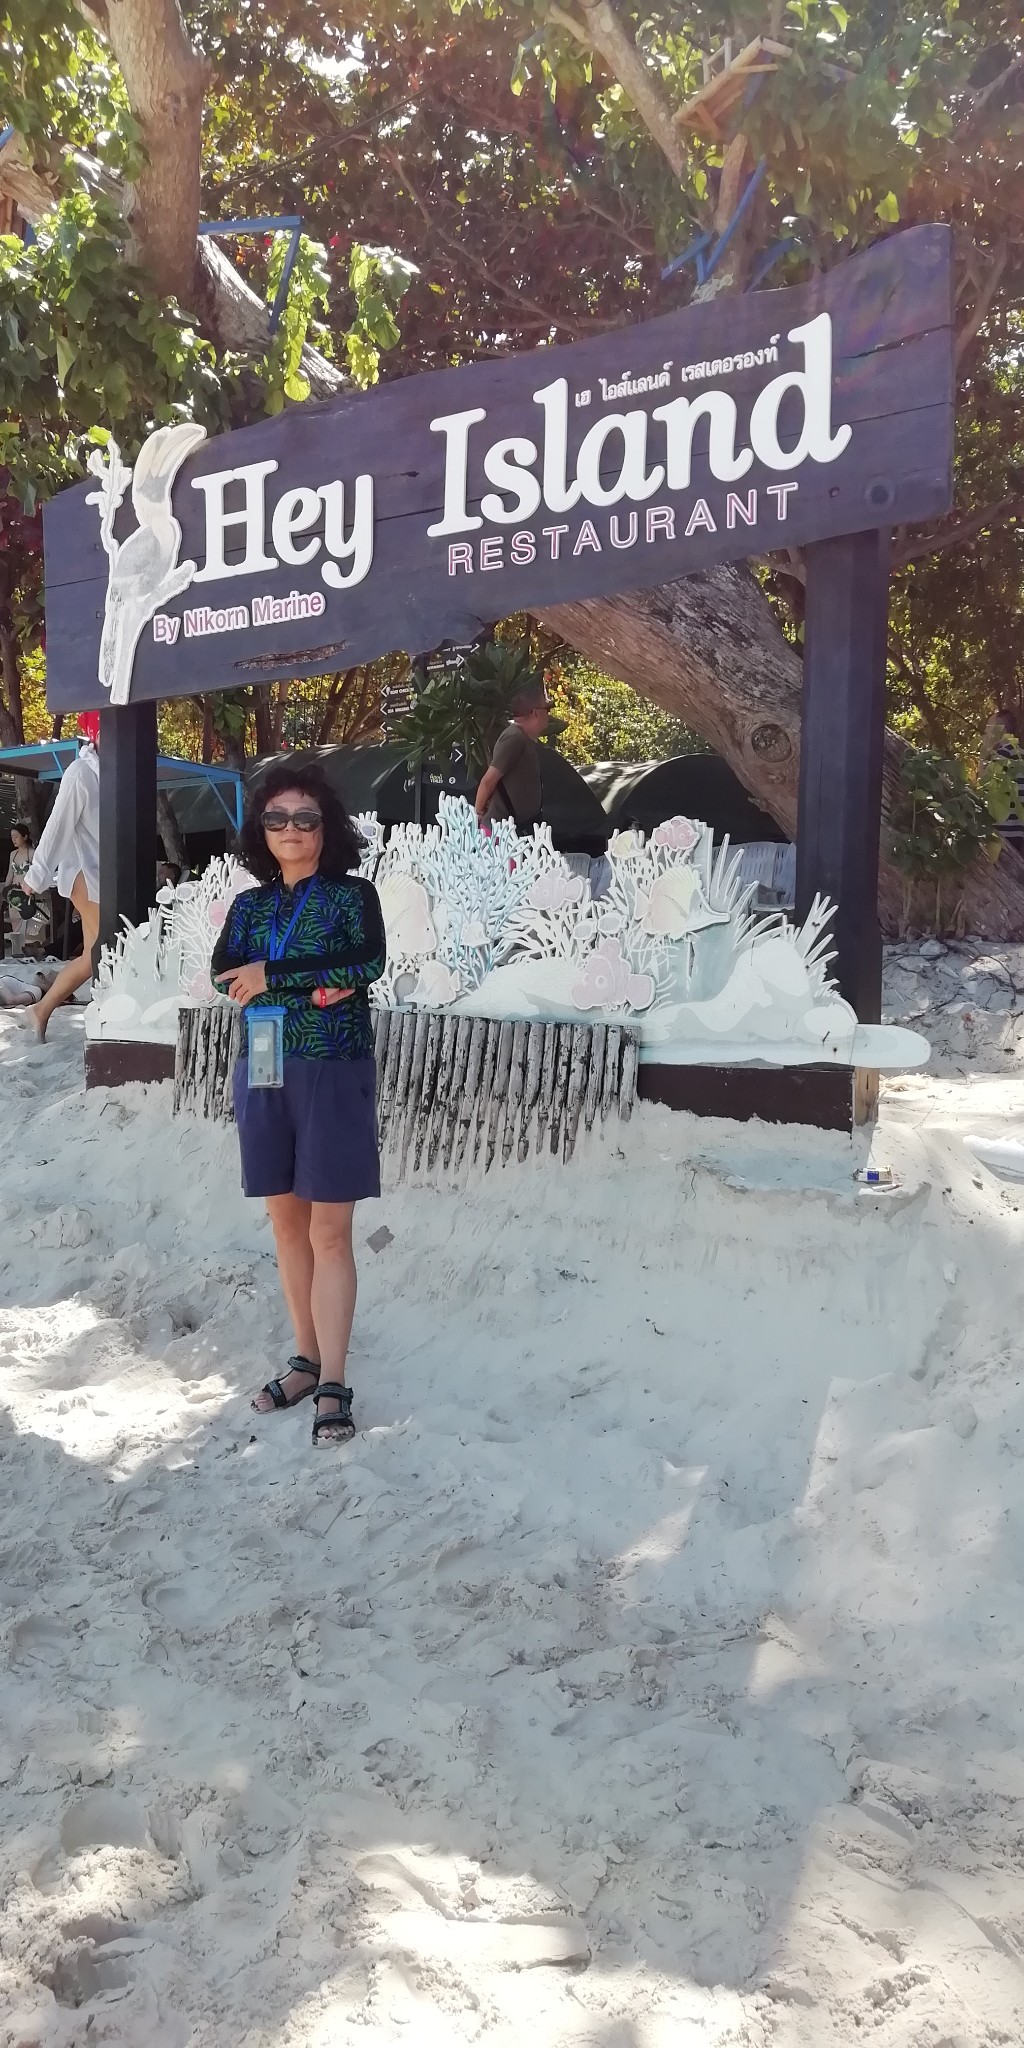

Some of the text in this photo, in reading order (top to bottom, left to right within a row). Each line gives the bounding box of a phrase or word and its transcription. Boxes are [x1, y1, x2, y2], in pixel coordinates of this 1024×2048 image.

[575, 389, 591, 407] เฮ
[598, 361, 673, 401] ไอส์แลนด์
[191, 312, 852, 588] Hey Island
[448, 482, 798, 576] RESTAURANT
[154, 591, 326, 644] By Nikorn Marine
